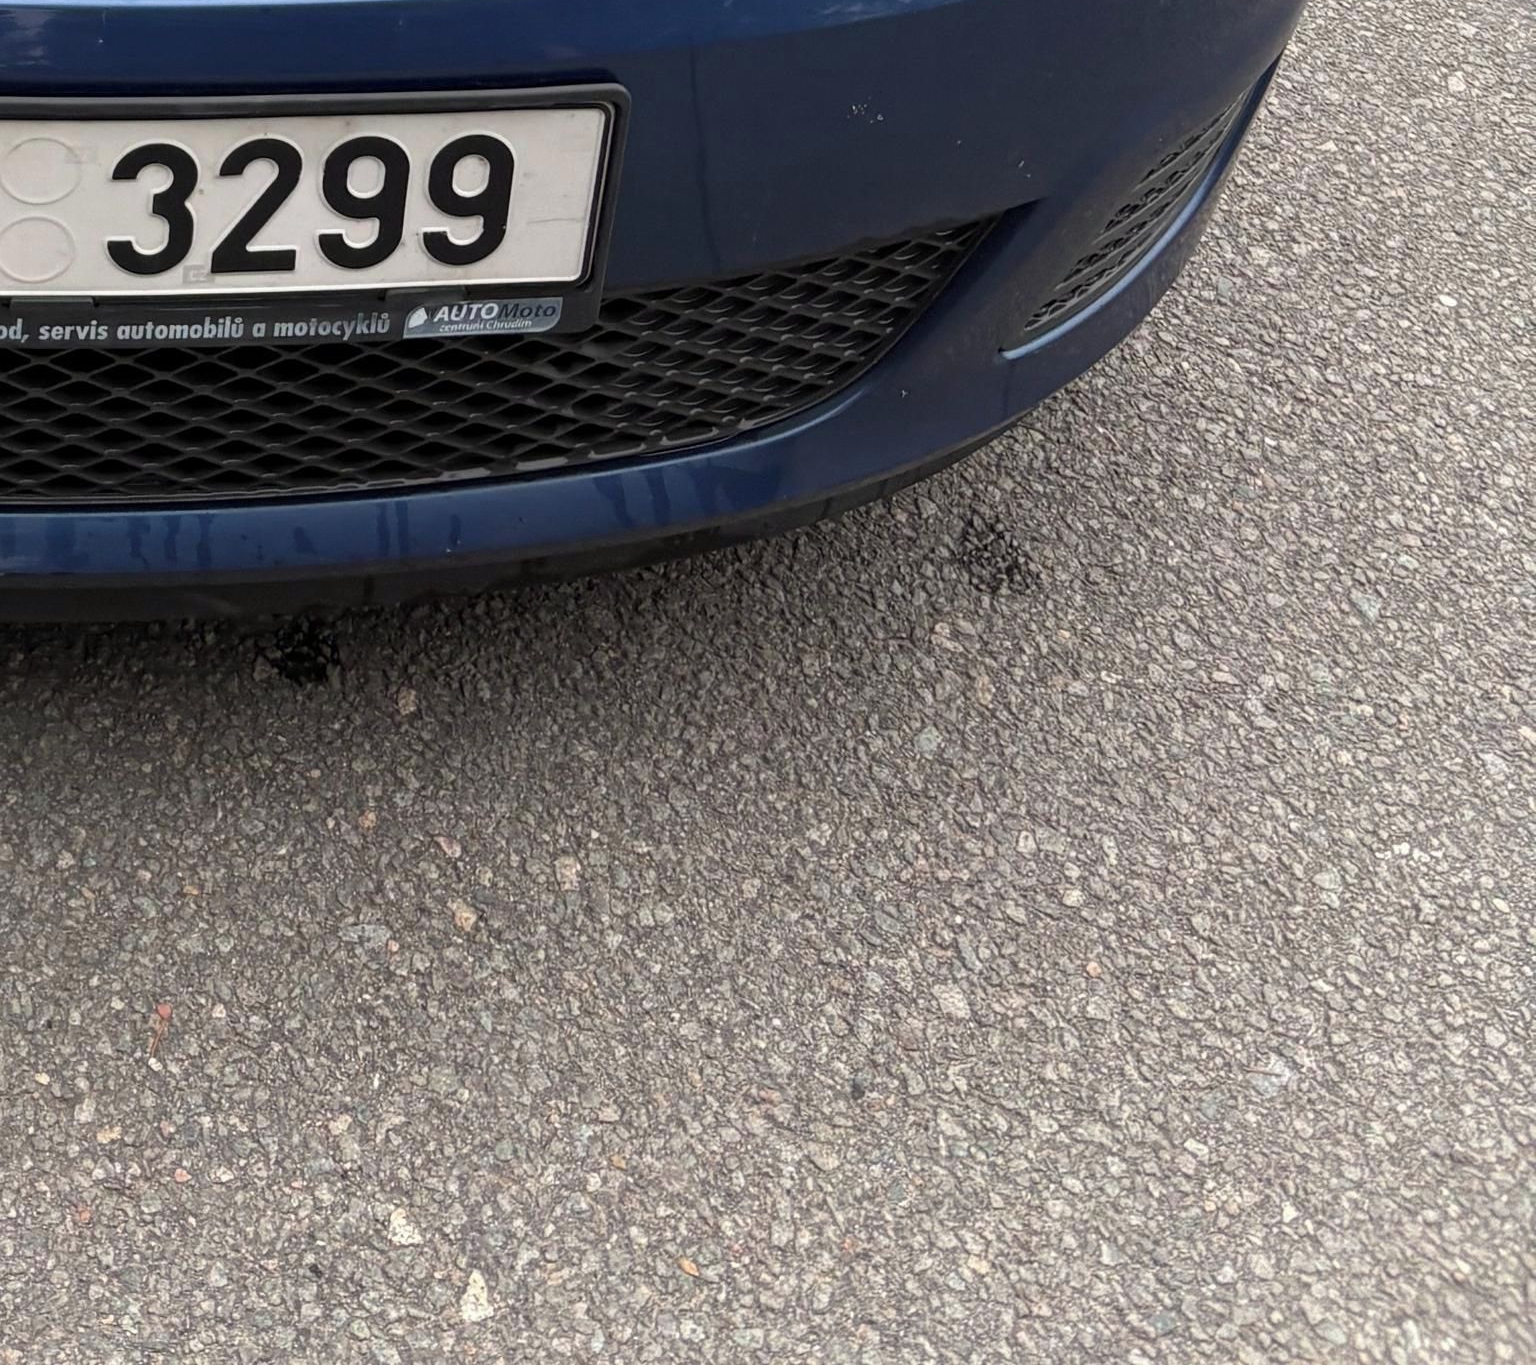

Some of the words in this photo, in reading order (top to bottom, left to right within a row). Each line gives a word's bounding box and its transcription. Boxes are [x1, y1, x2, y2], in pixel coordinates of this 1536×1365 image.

[106, 133, 515, 276] 3299
[38, 319, 109, 340] servis
[116, 317, 244, 339] automobilů
[252, 320, 266, 338] a
[273, 312, 390, 340] motocyklů
[485, 318, 533, 330] Chrudim
